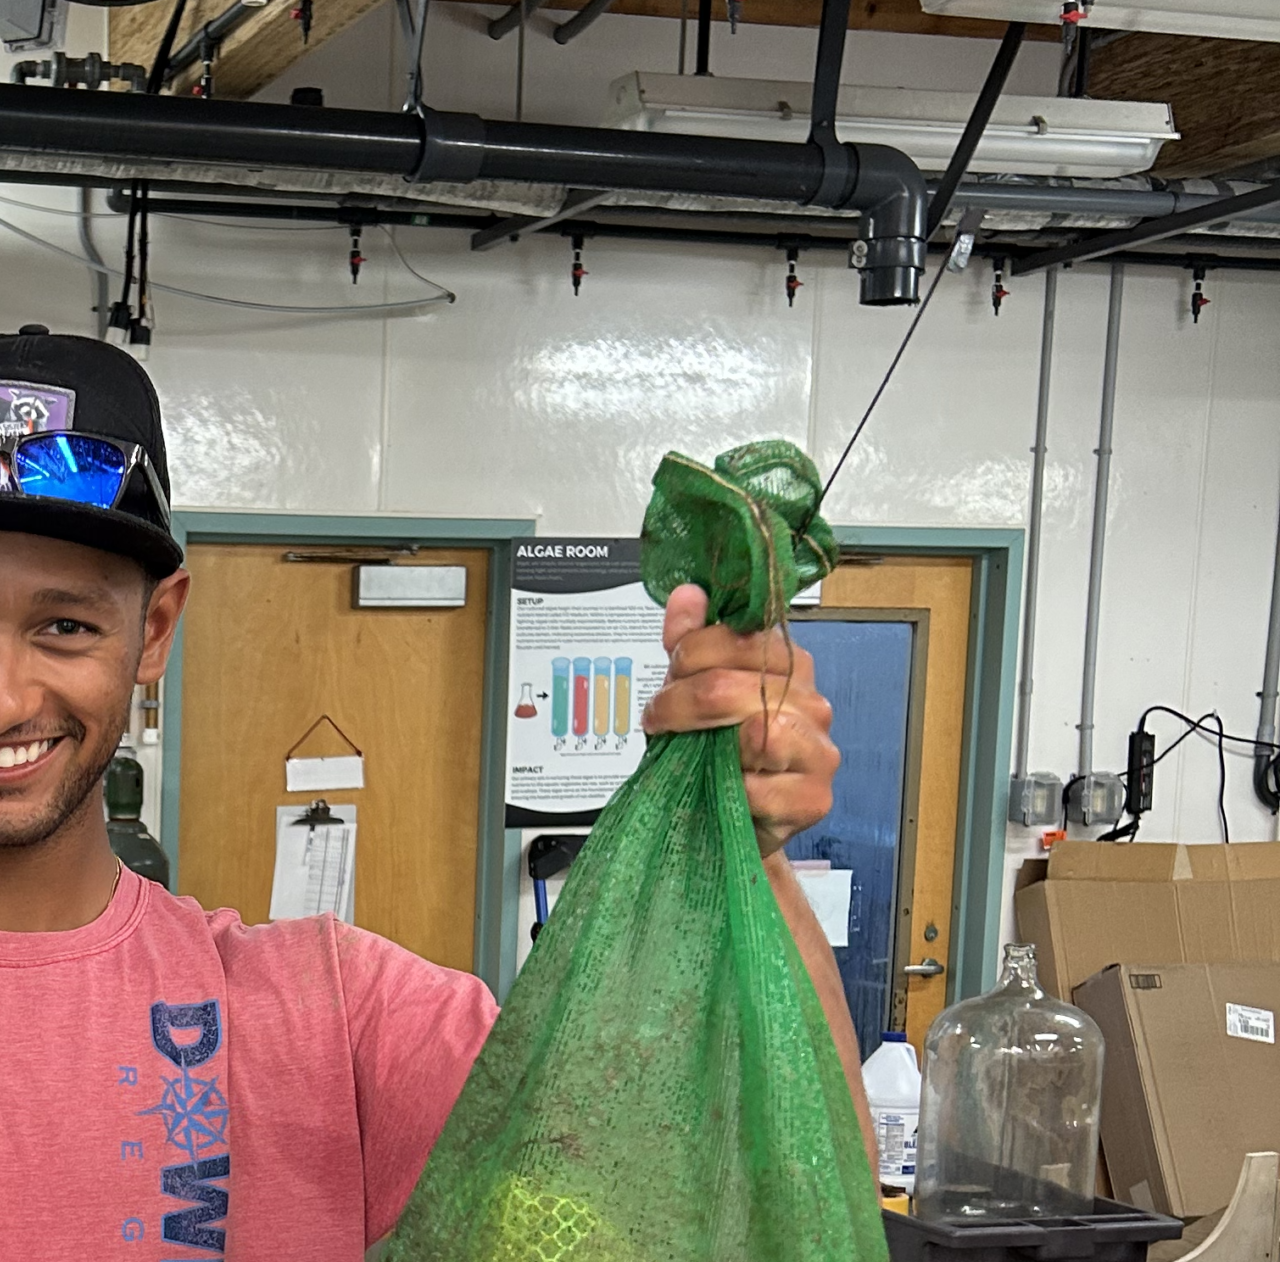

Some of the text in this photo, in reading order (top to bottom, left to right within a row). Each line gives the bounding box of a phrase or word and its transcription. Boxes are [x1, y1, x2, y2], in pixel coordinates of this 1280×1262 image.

[516, 545, 609, 558] ALGAE ROOM
[516, 598, 544, 606] SETUP
[512, 766, 544, 774] IMPACT
